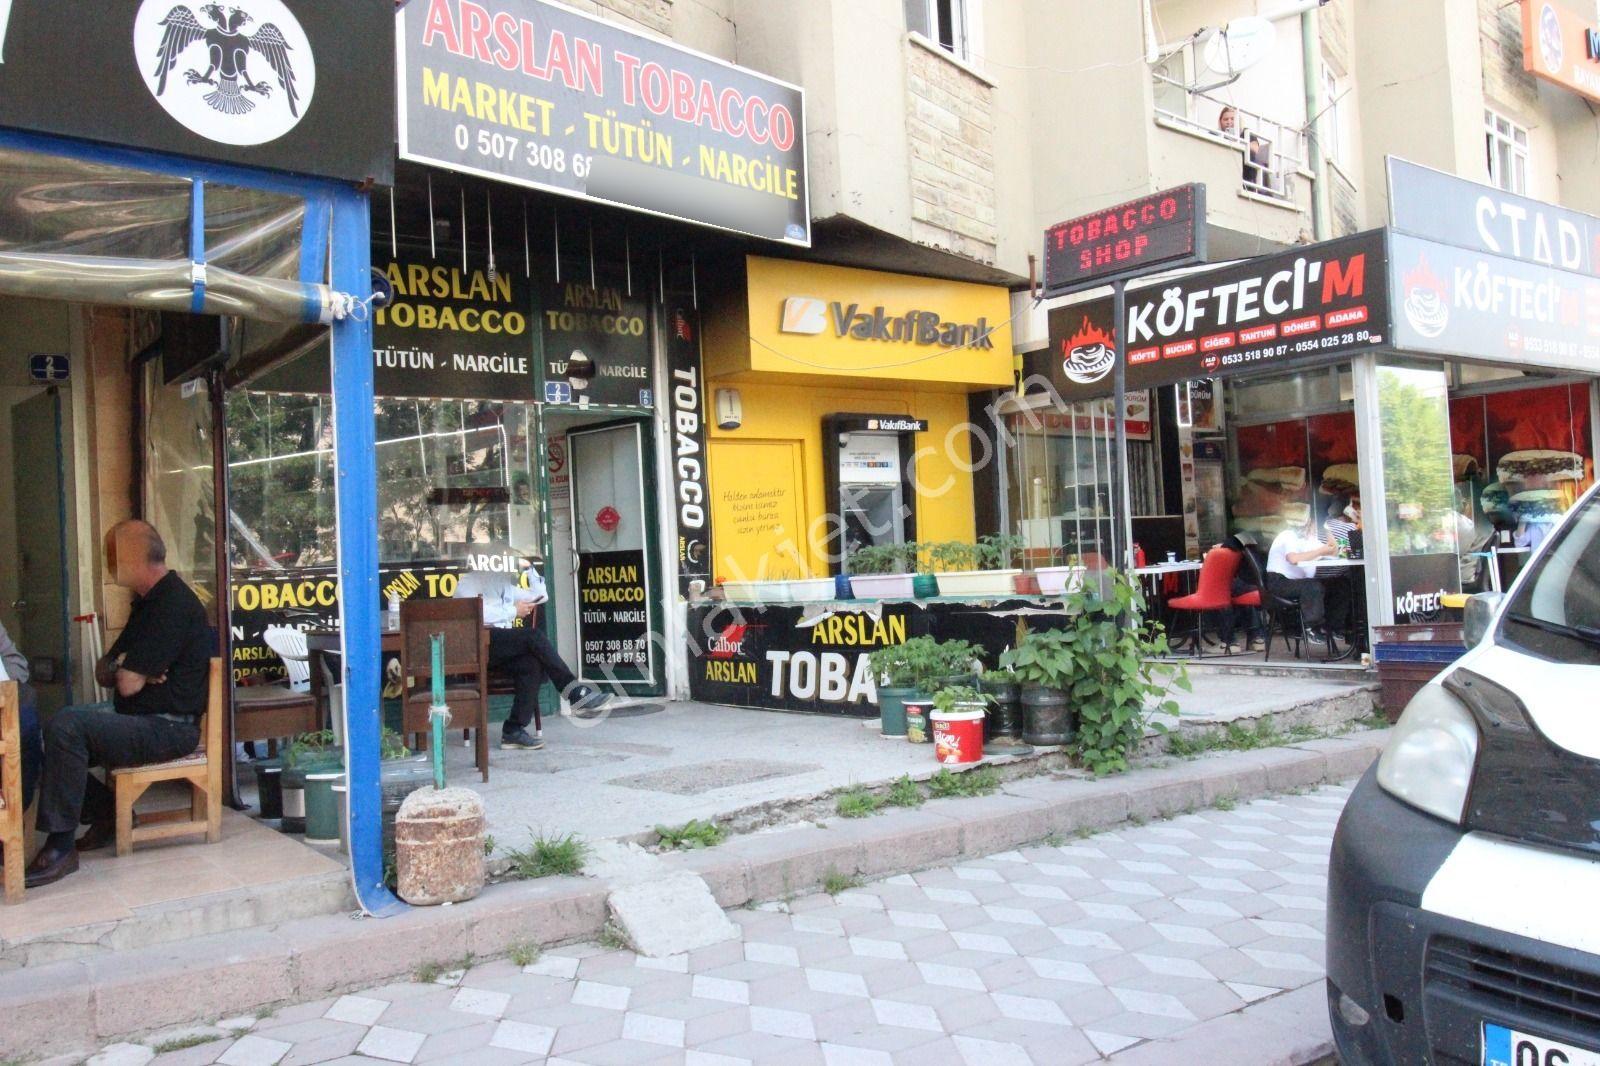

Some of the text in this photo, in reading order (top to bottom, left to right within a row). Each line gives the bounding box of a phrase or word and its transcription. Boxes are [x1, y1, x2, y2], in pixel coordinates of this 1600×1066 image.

[423, 0, 795, 151] ARSLAN TOBACCO
[423, 67, 555, 136] MARKET
[584, 109, 673, 168] TÜTÜN
[699, 144, 799, 200] NARGİLE
[455, 124, 468, 150] 0
[478, 130, 518, 161] 507
[526, 141, 566, 173] 308
[1054, 197, 1178, 249] TOBACCO
[1080, 234, 1149, 270] SHOP
[386, 263, 513, 303] ARSLAN
[1128, 254, 1365, 343] KÖFTECİ'M
[375, 302, 526, 335] TOBACCO
[546, 310, 645, 336] TOBACCO
[831, 301, 994, 352] VakıfBank
[1131, 350, 1156, 362] KÖFTE
[1165, 342, 1195, 355] SUCUK
[1204, 336, 1230, 348] CİĞER
[1240, 326, 1276, 341] TANTUNİ
[1283, 320, 1317, 333] DÖNER
[1222, 353, 1243, 365] 0533
[1245, 349, 1261, 361] 518
[1263, 348, 1274, 358] 90
[1276, 345, 1288, 355] 87
[1296, 340, 1318, 352] 0554
[1321, 336, 1339, 347] 025
[1342, 333, 1354, 345] 28
[1357, 330, 1369, 341] 80
[373, 345, 434, 369] TÜTÜN
[453, 352, 528, 374] NARGİLE
[600, 364, 647, 378] NARGİLE
[880, 419, 921, 431] VakıfBank
[674, 366, 705, 528] TOBACCO
[587, 565, 637, 585] ARSLAN
[231, 580, 340, 611] TOBACC
[582, 586, 645, 603] TOBACCO
[583, 609, 607, 623] TÜTÜN
[613, 608, 646, 623] NARGİLE
[812, 614, 906, 646] ARSLAN
[233, 645, 281, 660] ARSLA
[585, 639, 646, 651] 0507 308 68 70
[586, 651, 647, 663] 0546 218 87 58
[707, 636, 743, 654] Calbor
[706, 660, 756, 684] ARSLAN
[766, 650, 891, 704] TOBA
